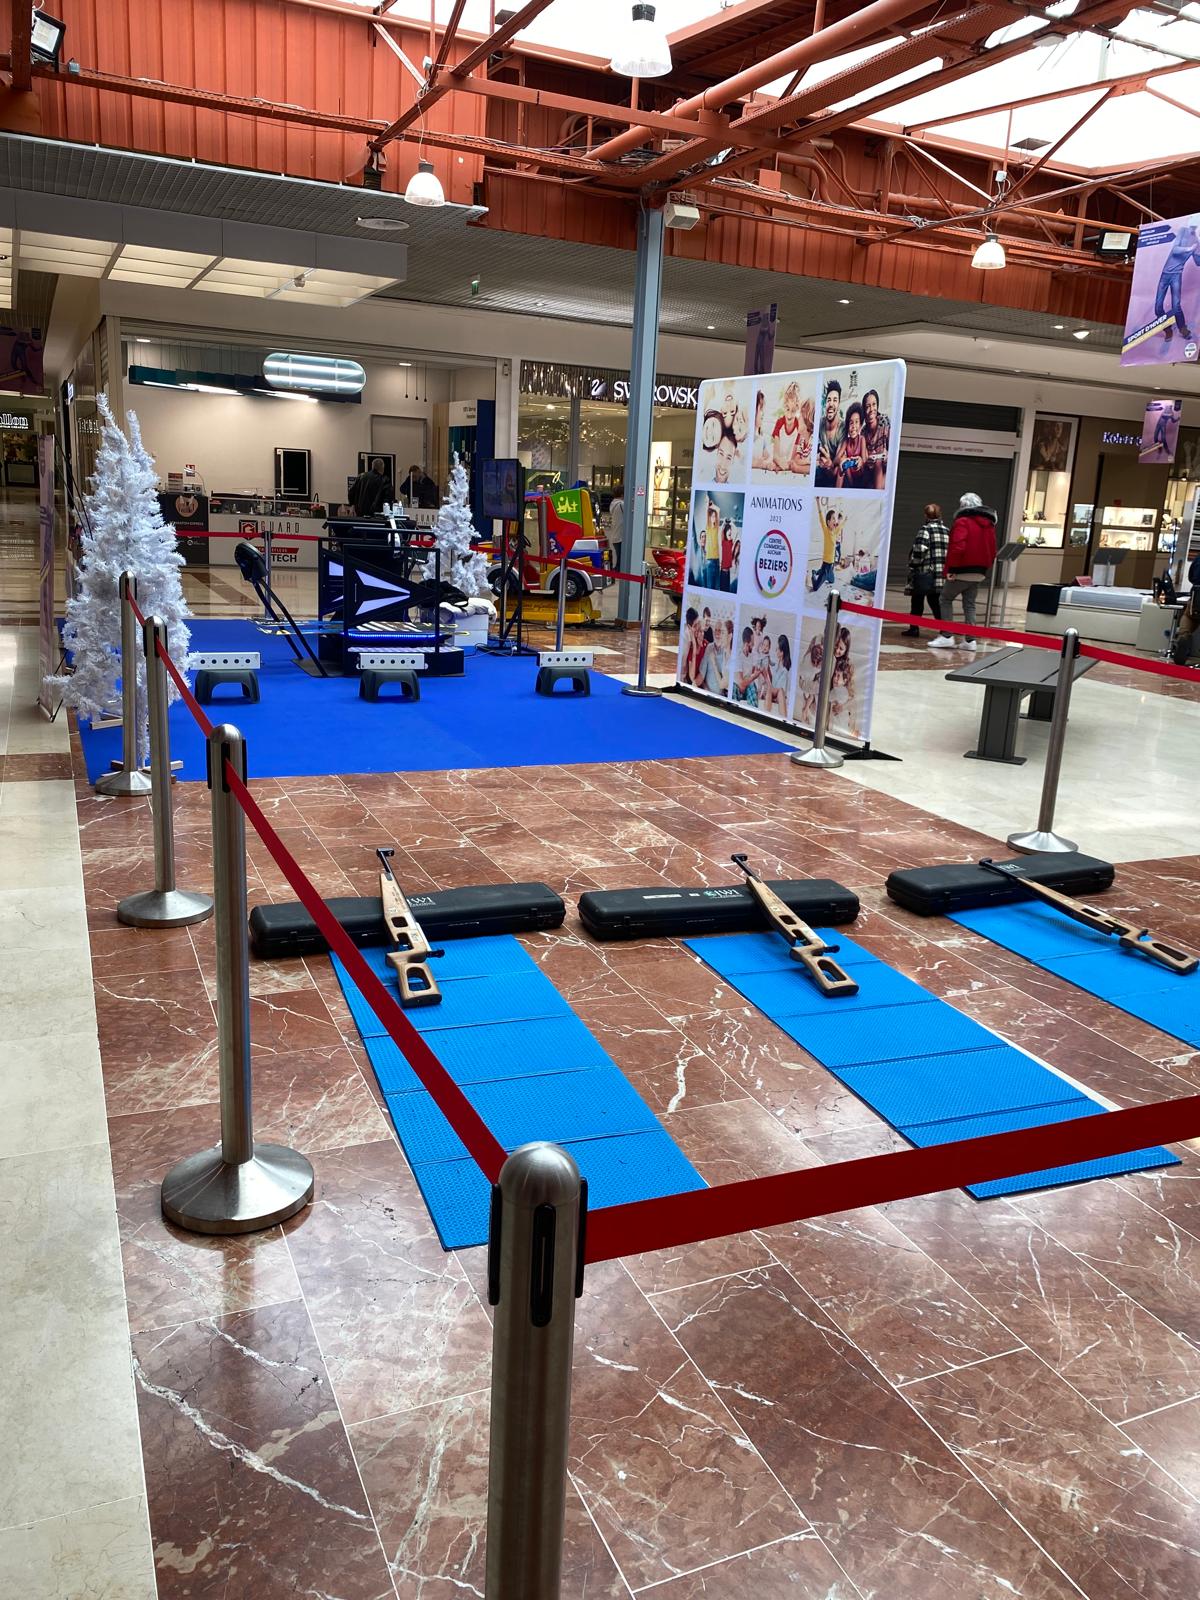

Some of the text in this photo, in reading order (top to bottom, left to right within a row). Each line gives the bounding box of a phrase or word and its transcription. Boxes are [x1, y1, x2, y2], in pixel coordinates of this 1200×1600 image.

[1127, 314, 1168, 343] SPORT D'HIVER
[750, 496, 803, 512] ANIMATIONS
[260, 520, 300, 533] GUARD
